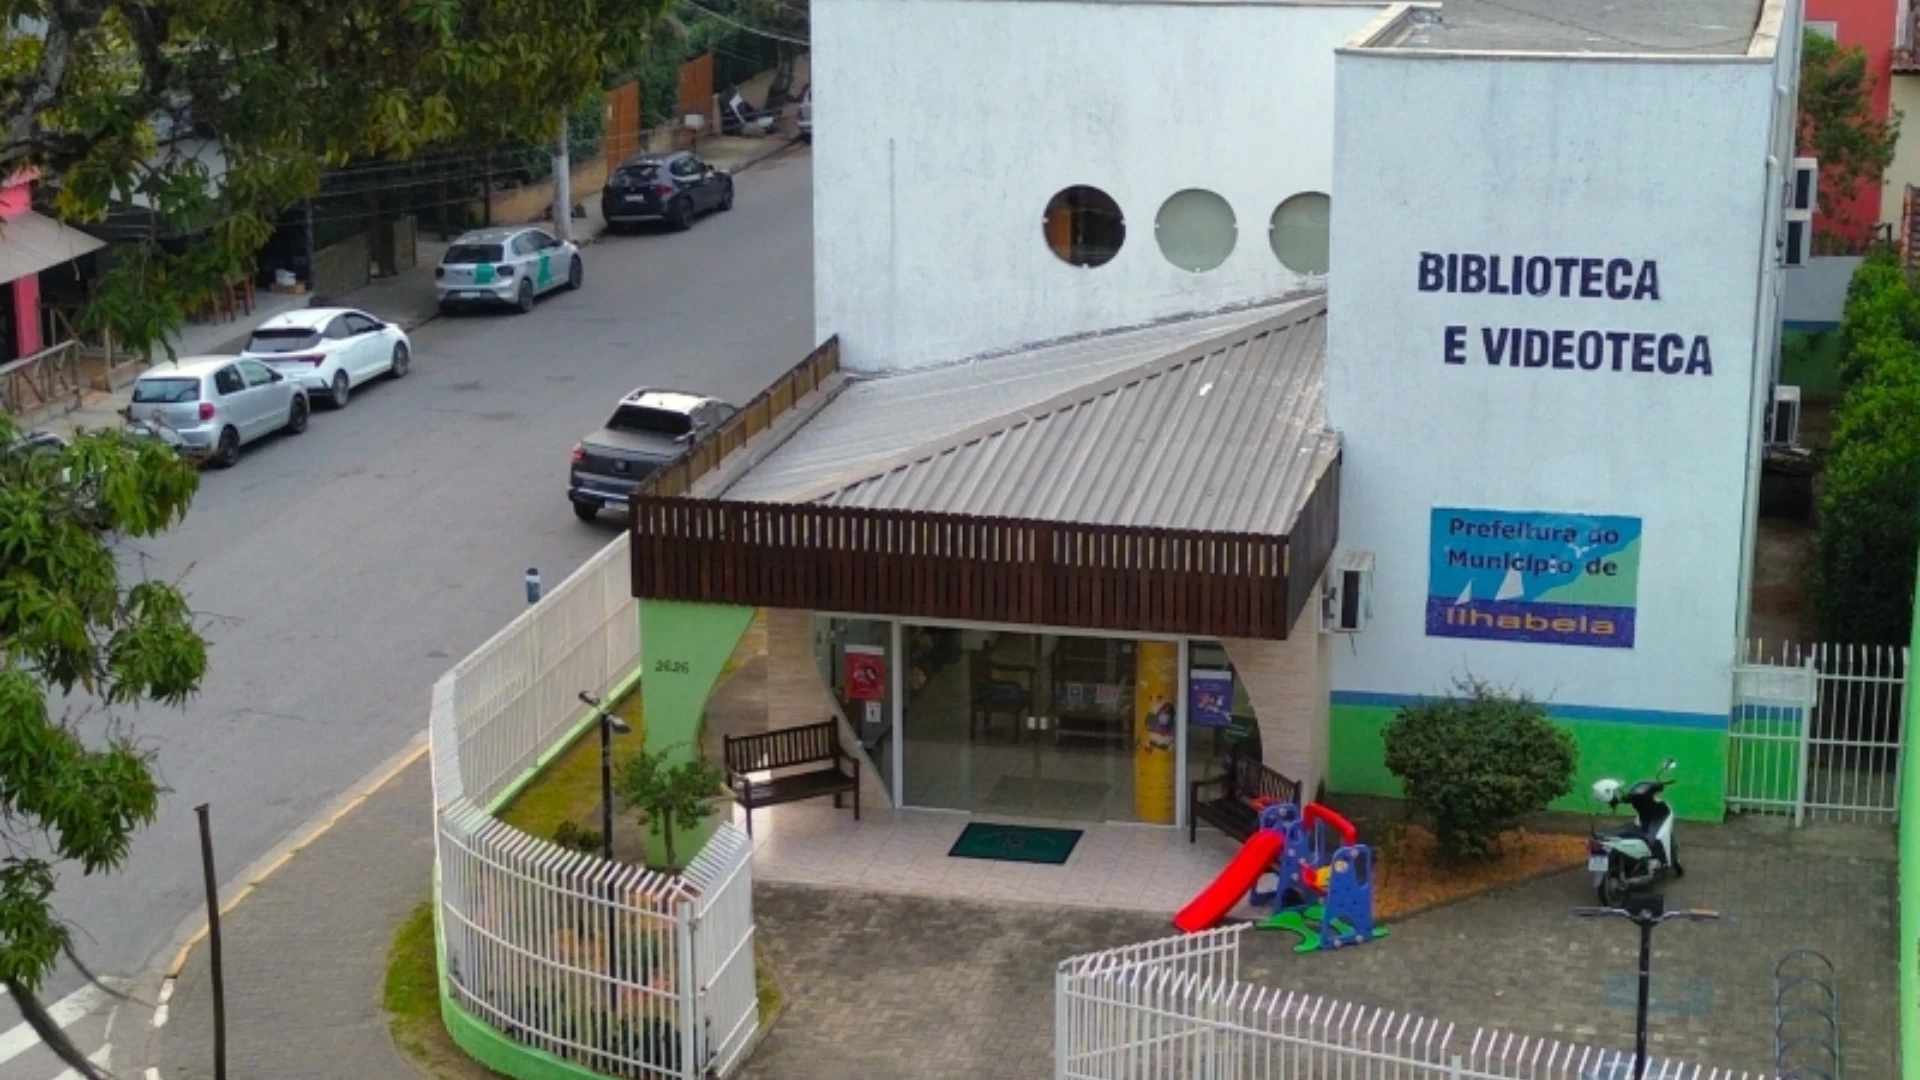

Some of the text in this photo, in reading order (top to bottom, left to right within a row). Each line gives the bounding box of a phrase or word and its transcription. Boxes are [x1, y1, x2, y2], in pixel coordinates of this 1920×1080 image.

[1418, 251, 1660, 301] BIBLIOTECA
[1444, 325, 1713, 376] E VIDEOTECA
[1450, 517, 1620, 545] Prefeitura do
[1585, 557, 1618, 576] de
[1446, 606, 1616, 635] Ilhabela
